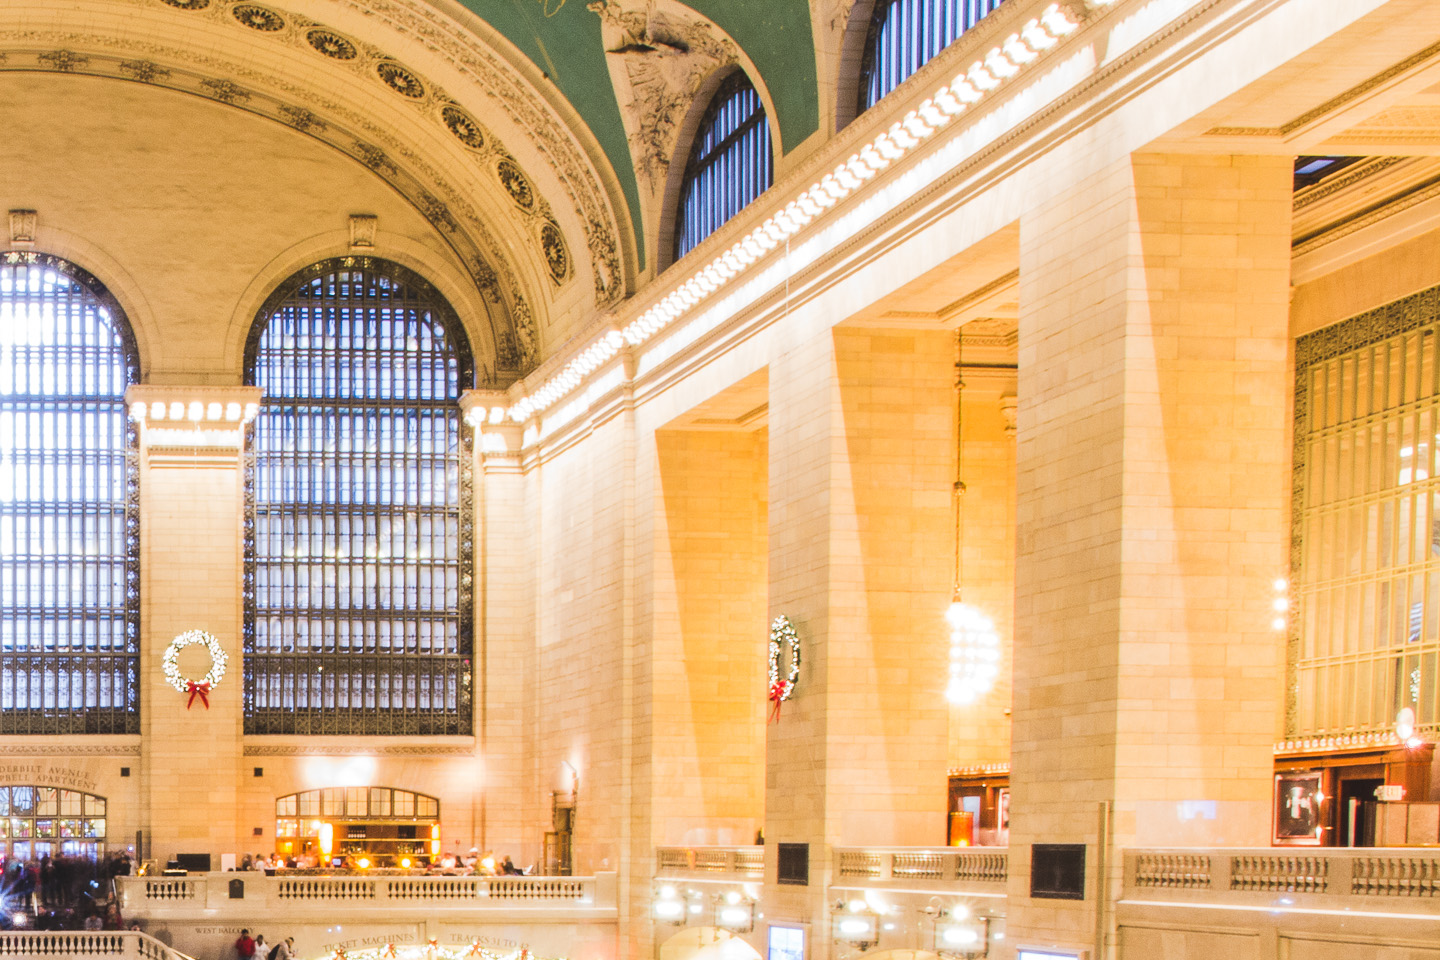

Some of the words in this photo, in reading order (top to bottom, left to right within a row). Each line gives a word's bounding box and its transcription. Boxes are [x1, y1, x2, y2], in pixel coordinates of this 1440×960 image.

[48, 767, 90, 779] AVENUE
[36, 774, 98, 791] APARTMENT
[195, 927, 216, 935] WEST
[322, 938, 358, 952] TICKET
[362, 933, 415, 946] MACHINES
